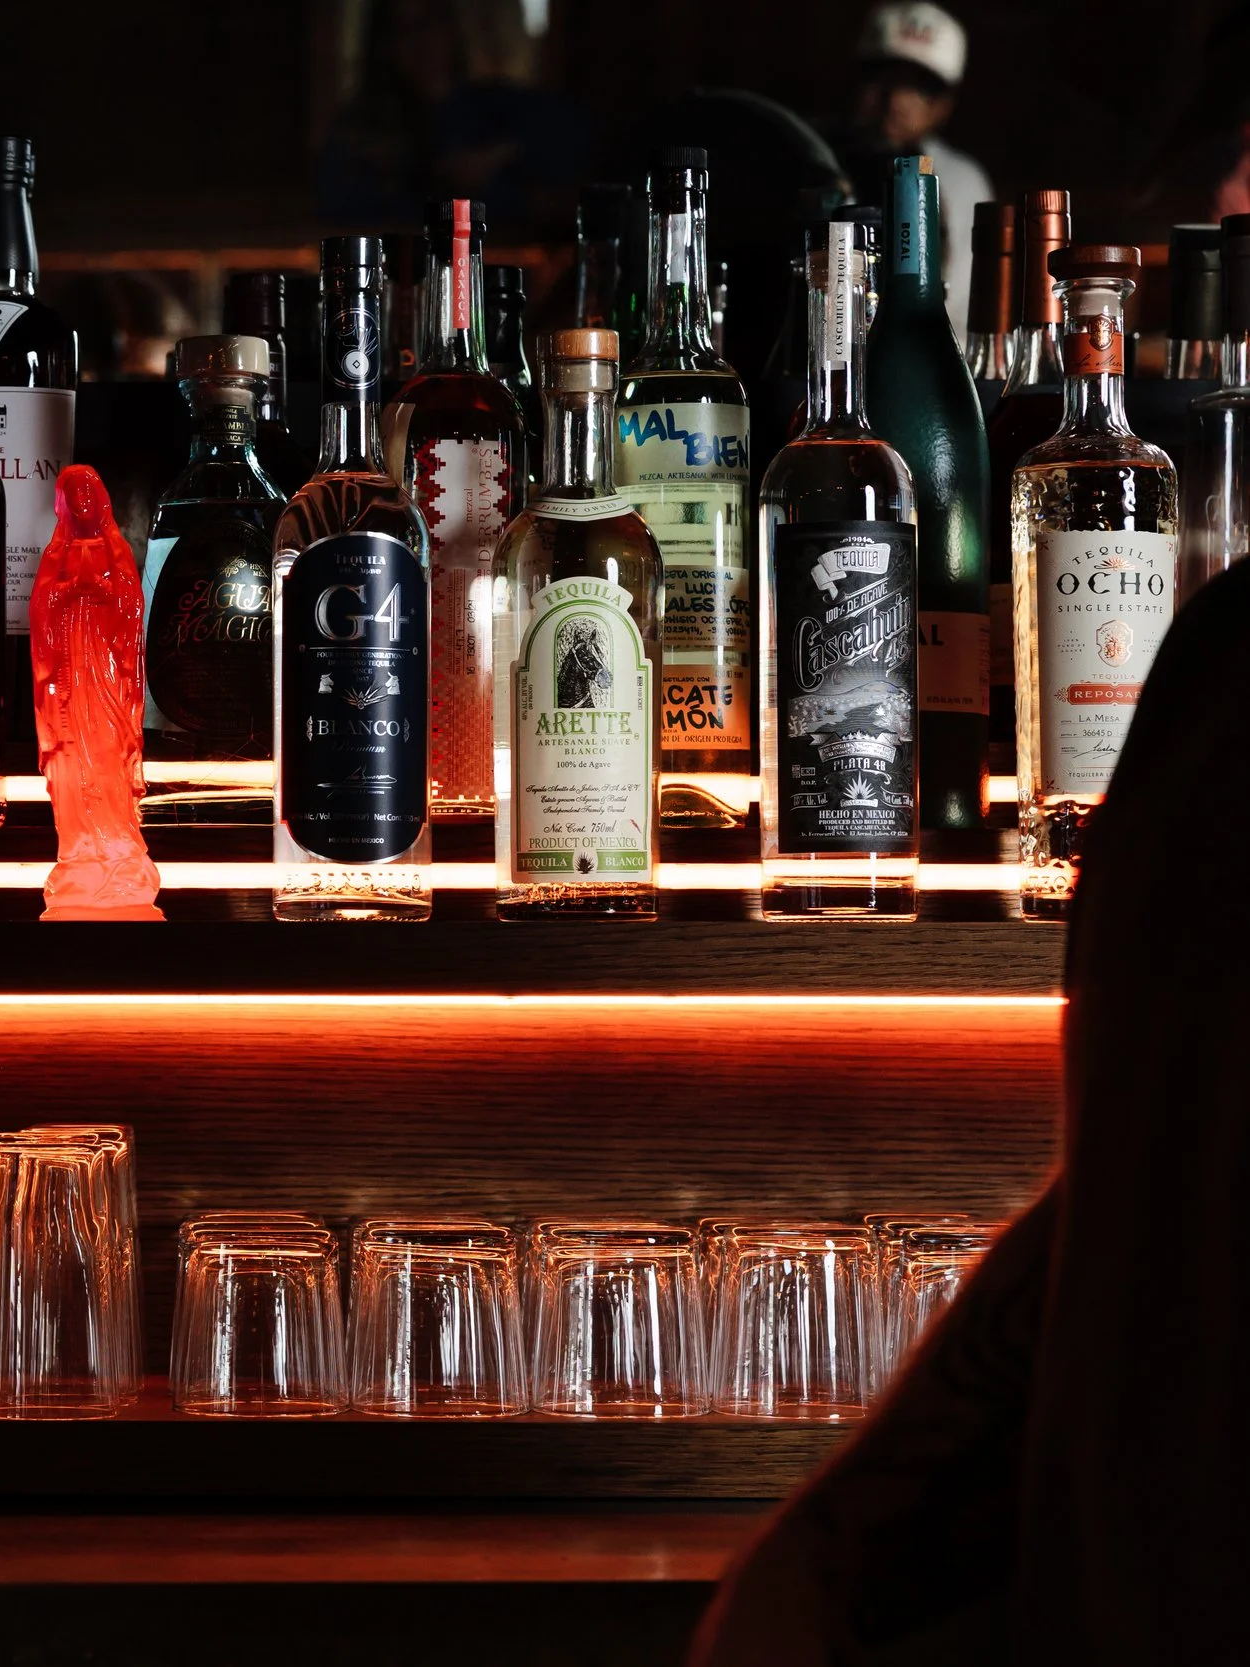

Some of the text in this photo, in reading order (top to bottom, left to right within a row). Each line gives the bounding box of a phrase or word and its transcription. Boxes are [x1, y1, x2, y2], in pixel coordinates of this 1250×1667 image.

[901, 222, 911, 262] BOZAL
[457, 257, 466, 321] OAXACA
[835, 238, 846, 355] CASCAHUIN TEQUILA
[619, 408, 750, 469] MAL BIEN
[639, 472, 665, 481] MEZCAL
[668, 472, 708, 480] ARTESANAL
[463, 487, 473, 523] mezcal
[478, 448, 493, 563] DERRUMBES
[540, 502, 618, 513] FAMILY OWNED
[22, 546, 41, 554] MALT
[1072, 546, 1155, 568] TEQUILA
[334, 553, 387, 567] TEQUILA
[833, 551, 881, 569] TEQUILA
[1056, 571, 1164, 596] OCHO
[543, 582, 622, 606] TEQUILA
[861, 582, 888, 606] AGAVE
[314, 582, 410, 643] G4
[1057, 604, 1163, 614] SINGLE ESTATE
[1074, 690, 1142, 699] REPOSAD
[316, 719, 400, 736] BLANCO
[535, 711, 633, 736] ARETTE
[671, 735, 682, 743] DE
[684, 735, 712, 743] ORIGEN
[1082, 729, 1106, 737] 36645
[537, 738, 631, 746] ARTESANAL SUAVE
[589, 761, 612, 770] Agave
[833, 757, 871, 771] PLATA
[373, 813, 387, 821] Net
[819, 810, 896, 819] HECHO EN MEXICO
[543, 819, 617, 833] Net. Cont. 750ml
[529, 837, 637, 849] PRODUCT OF MEXICO
[520, 856, 644, 869] TEQUILA BLANCO
